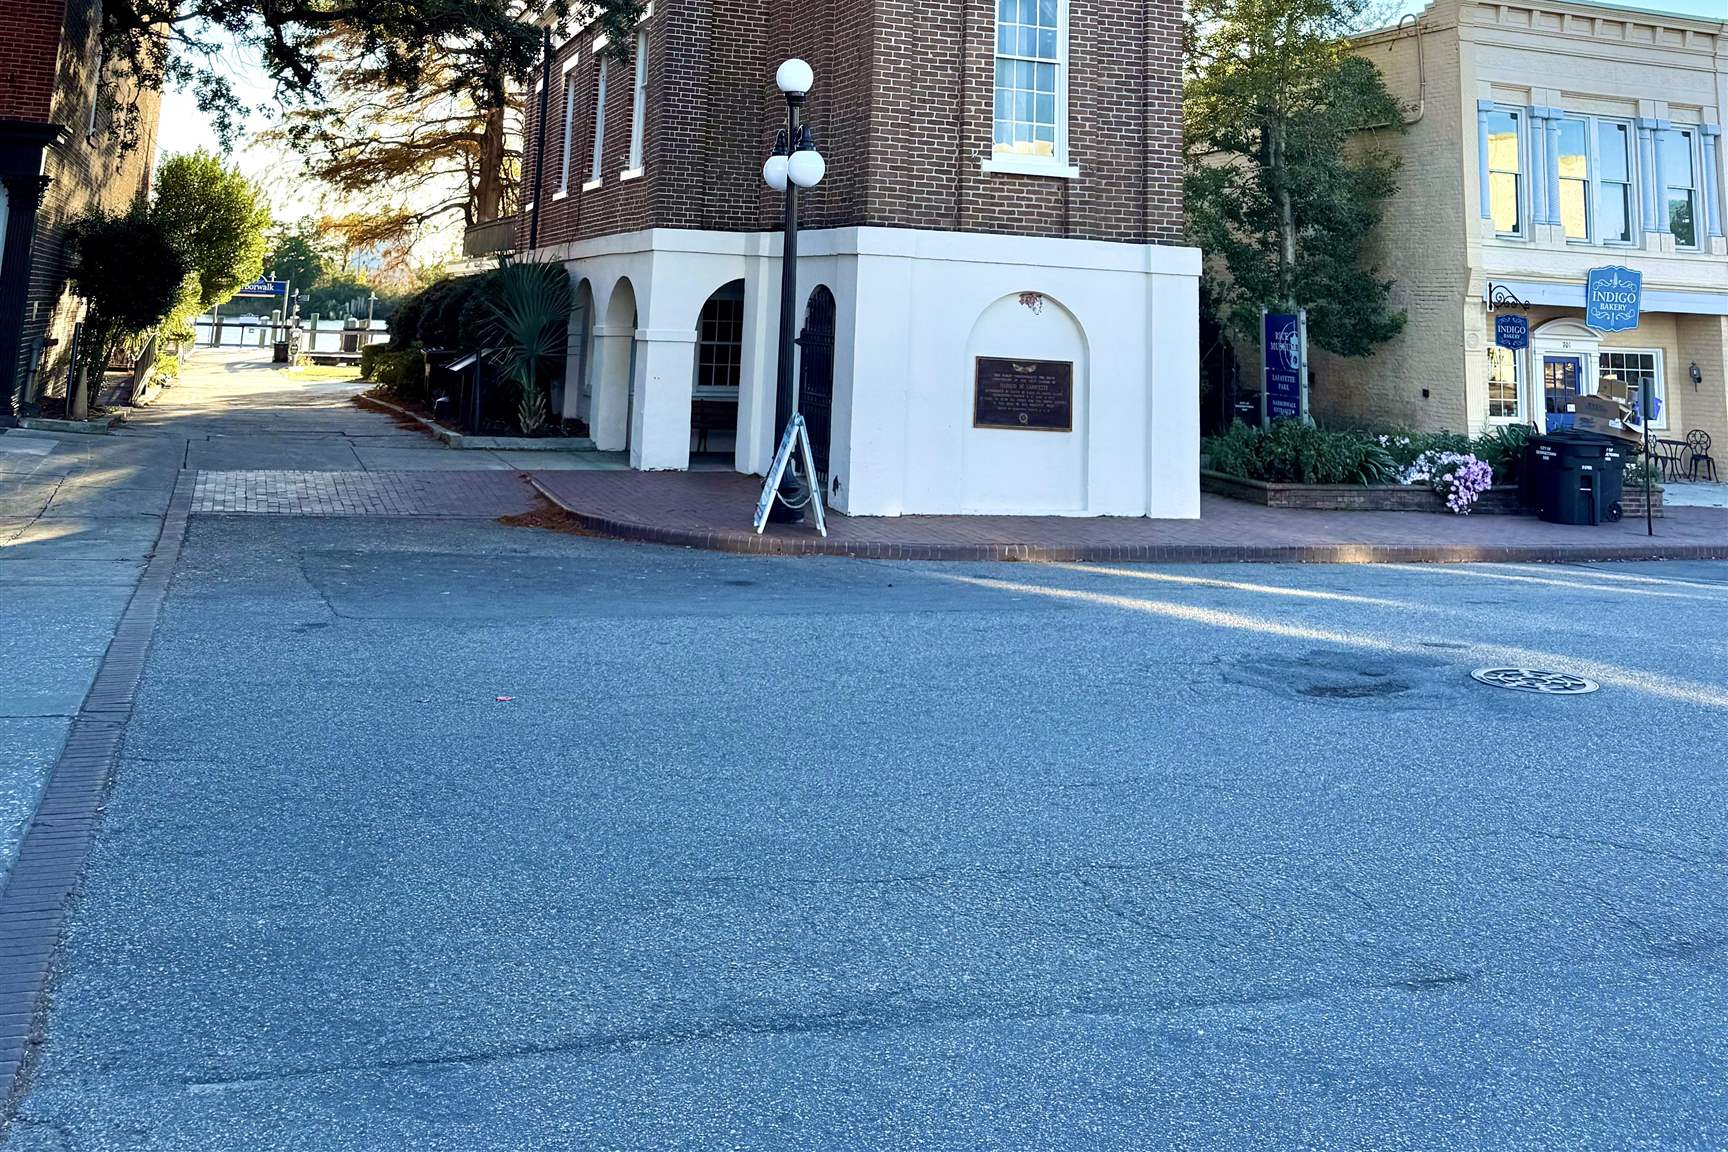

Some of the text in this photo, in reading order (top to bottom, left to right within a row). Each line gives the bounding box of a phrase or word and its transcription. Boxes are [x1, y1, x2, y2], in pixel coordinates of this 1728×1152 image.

[1592, 291, 1636, 304] INDIGO
[1600, 303, 1627, 311] BAKERY
[1498, 325, 1526, 334] INDIGO
